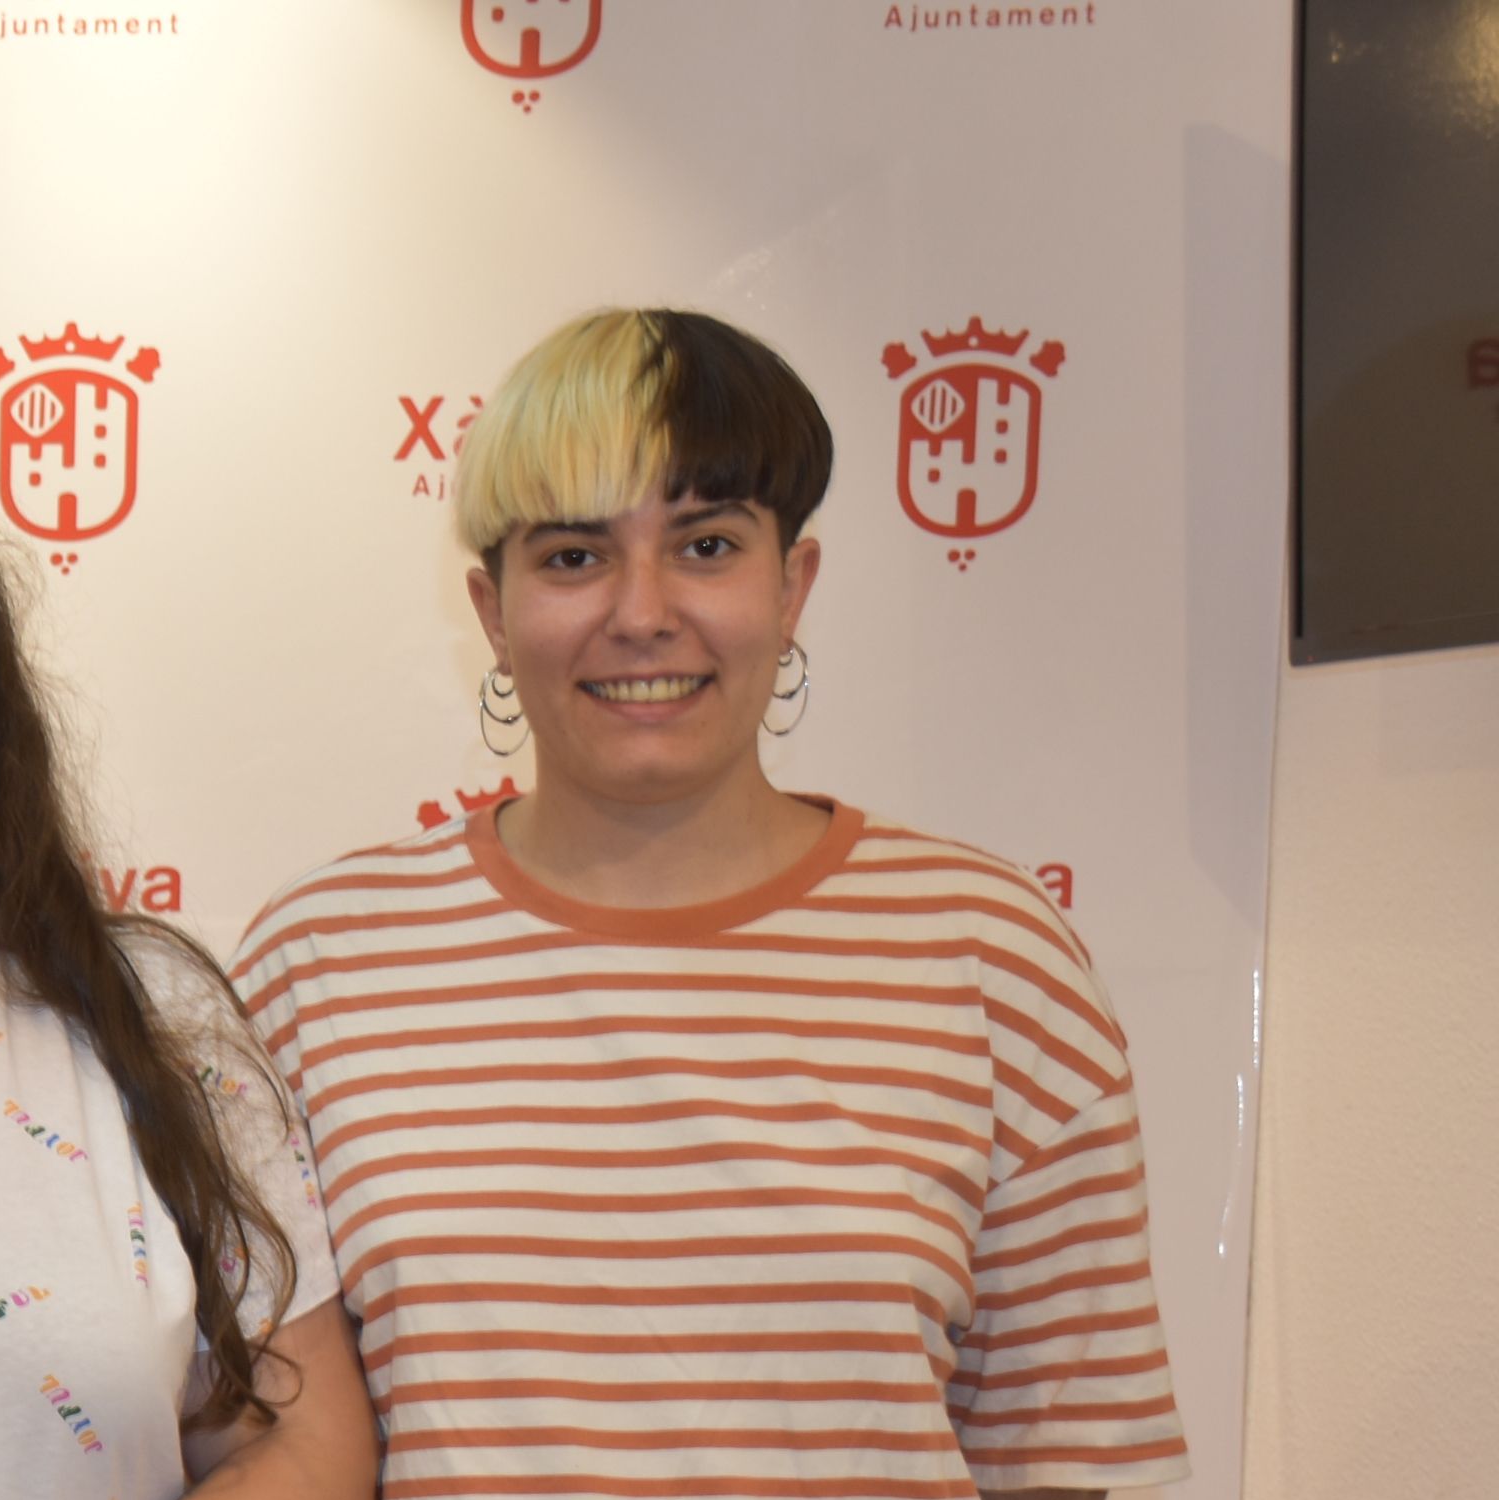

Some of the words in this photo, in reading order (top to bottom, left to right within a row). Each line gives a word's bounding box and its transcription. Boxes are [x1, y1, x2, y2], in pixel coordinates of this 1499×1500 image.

[884, 2, 1095, 32] Ajuntament
[3, 1099, 88, 1163] JOYFUL
[40, 1374, 102, 1454] JOYFUL
